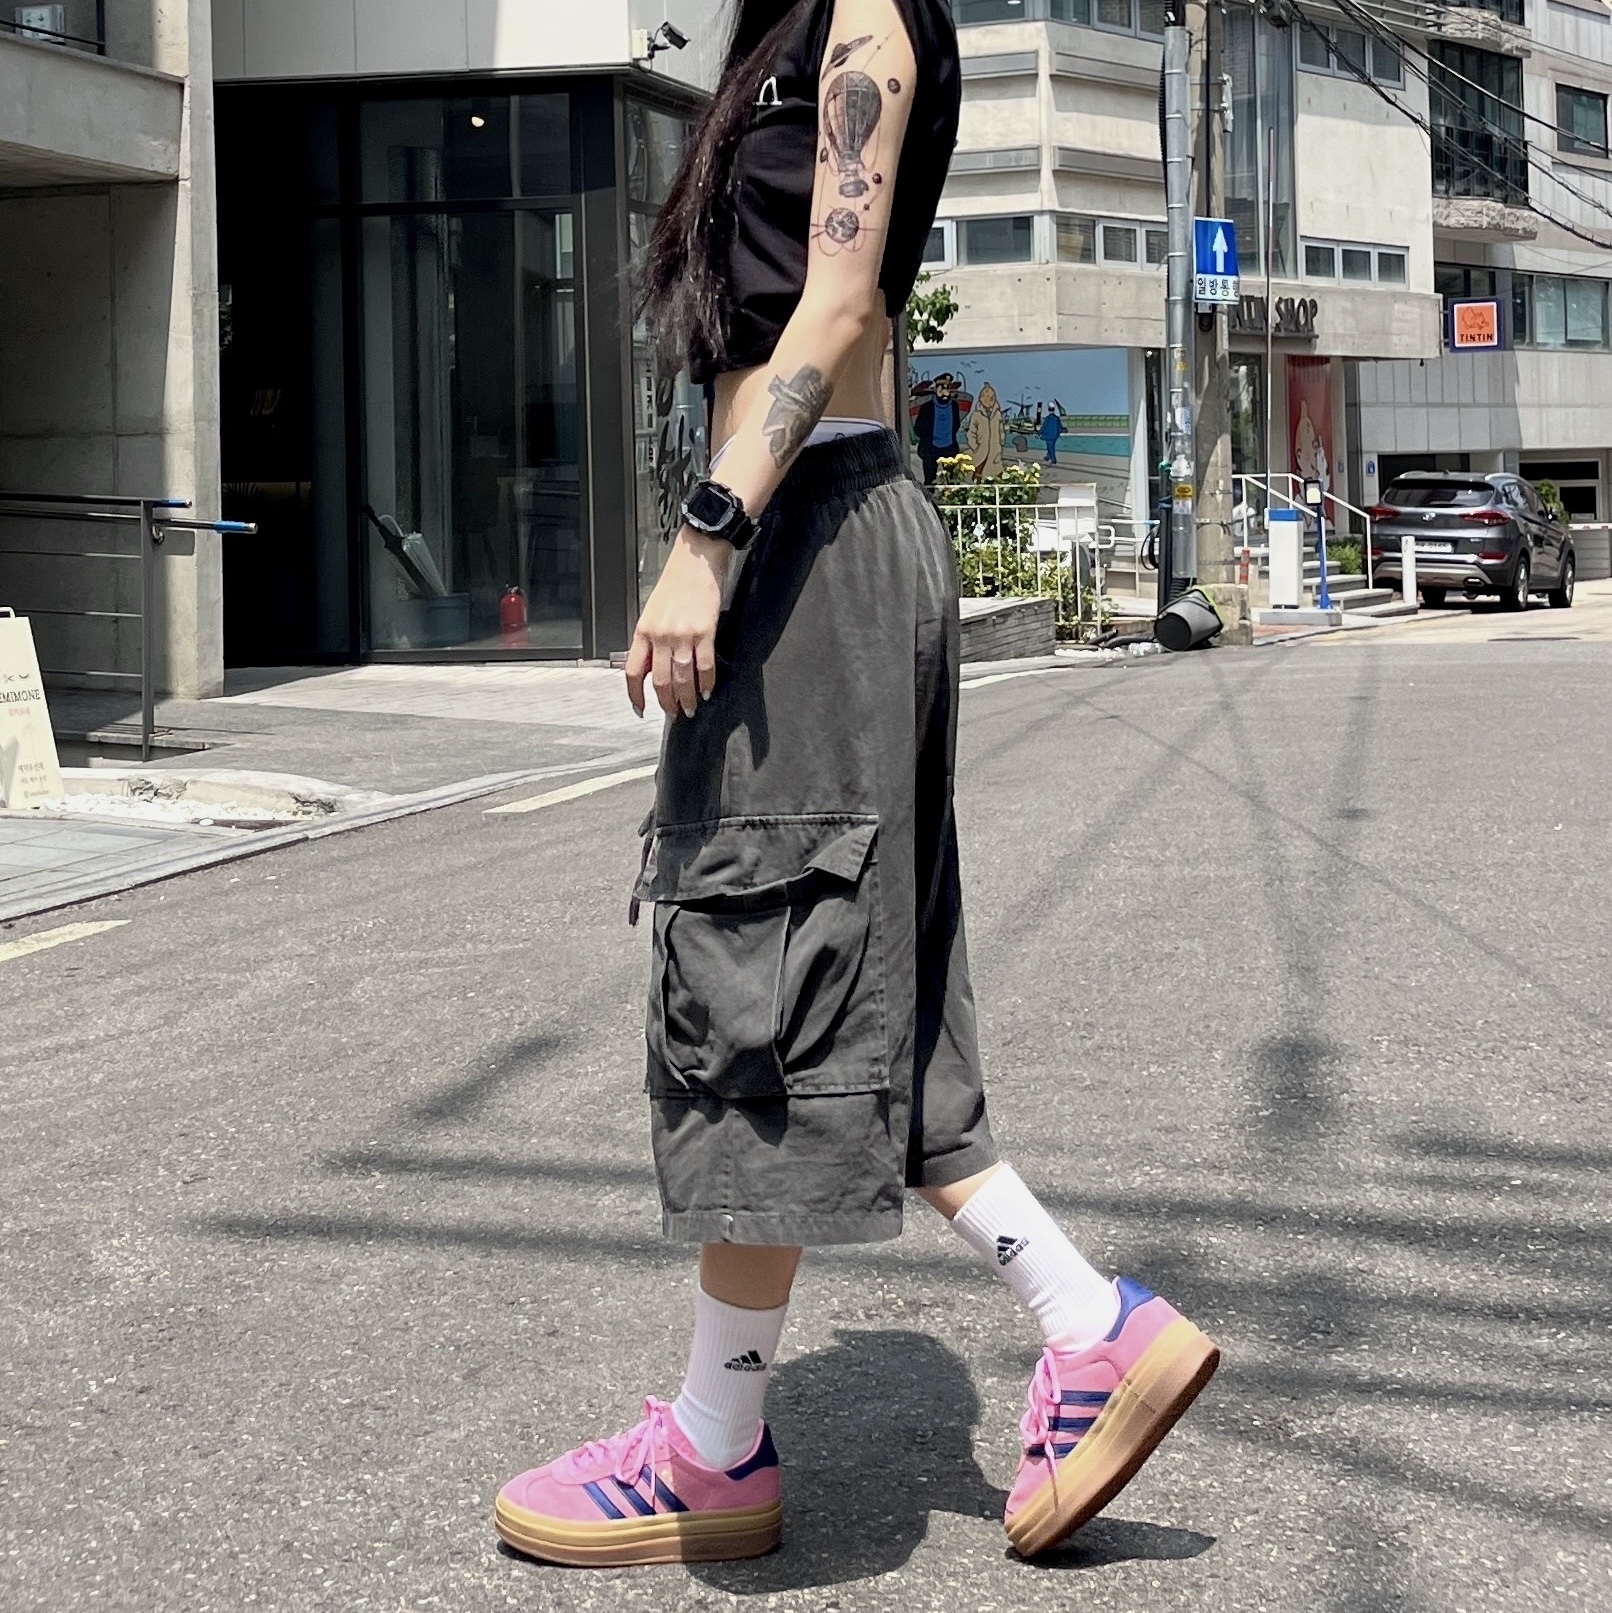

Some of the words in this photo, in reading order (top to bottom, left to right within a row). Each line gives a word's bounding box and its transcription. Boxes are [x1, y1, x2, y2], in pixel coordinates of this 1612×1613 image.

[1275, 296, 1318, 333] SHOP
[1460, 333, 1493, 342] TINTIN
[724, 1360, 767, 1372] adidas
